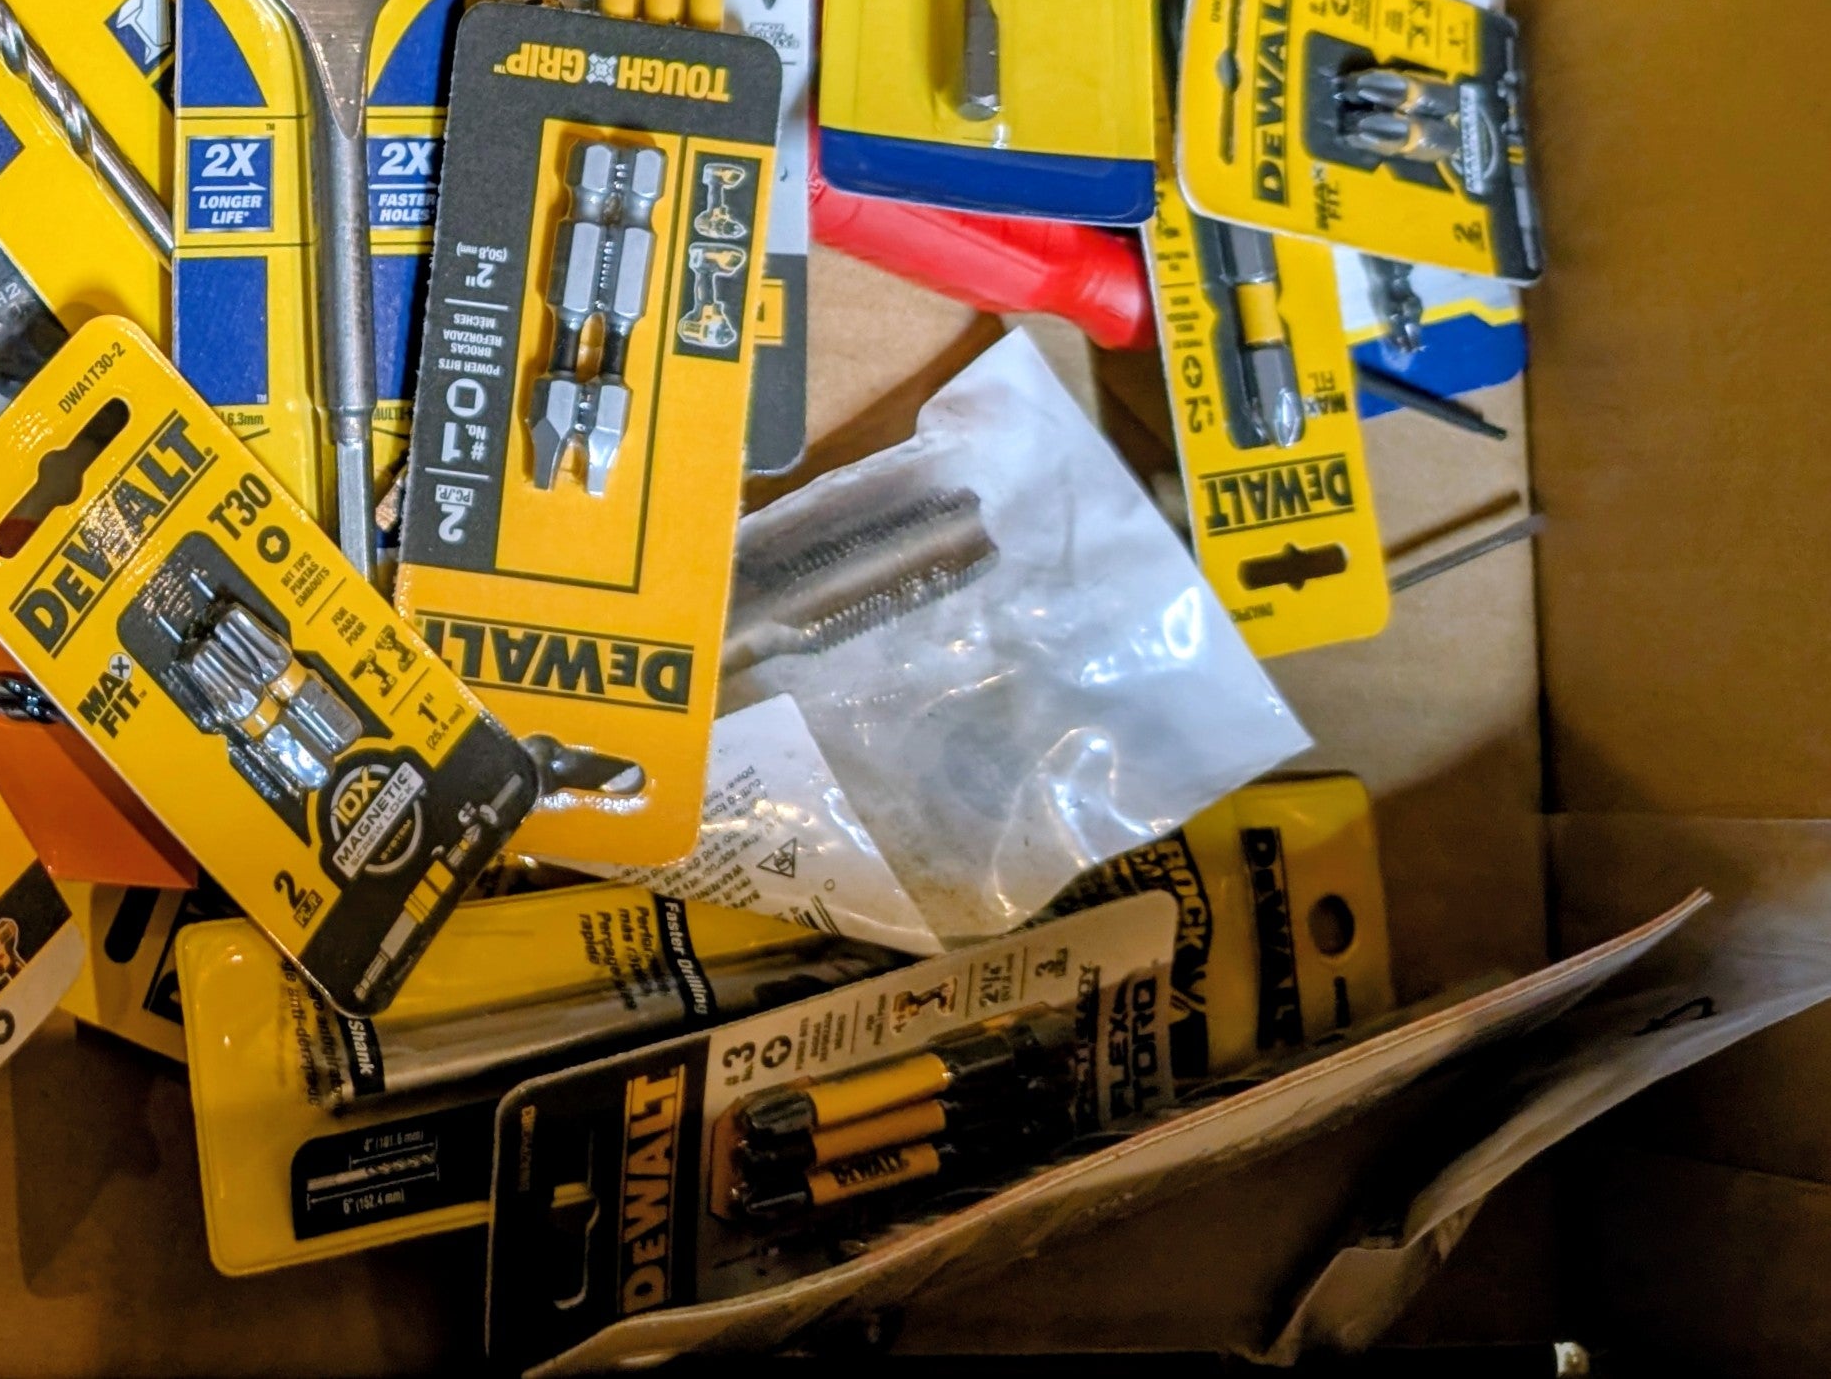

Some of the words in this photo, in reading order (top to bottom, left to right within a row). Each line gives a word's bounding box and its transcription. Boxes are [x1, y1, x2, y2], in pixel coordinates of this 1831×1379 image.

[616, 53, 732, 103] TOUGH
[200, 143, 259, 177] 2X
[377, 142, 436, 176] 2X
[198, 194, 263, 210] LONGER
[378, 193, 438, 207] FASTER
[442, 329, 503, 347] REFORZADA
[449, 342, 492, 358] BROCAS
[58, 340, 127, 416] DWA1T30-2
[437, 357, 465, 372] BITS
[465, 360, 502, 375] POWER
[206, 471, 273, 541] T30
[1203, 458, 1355, 532] DEWALT
[13, 413, 211, 655] DEWALT
[336, 772, 411, 868] MAGNETIC
[663, 901, 686, 963] Faster
[674, 964, 711, 1017] Drilling
[349, 1018, 376, 1077] Shank
